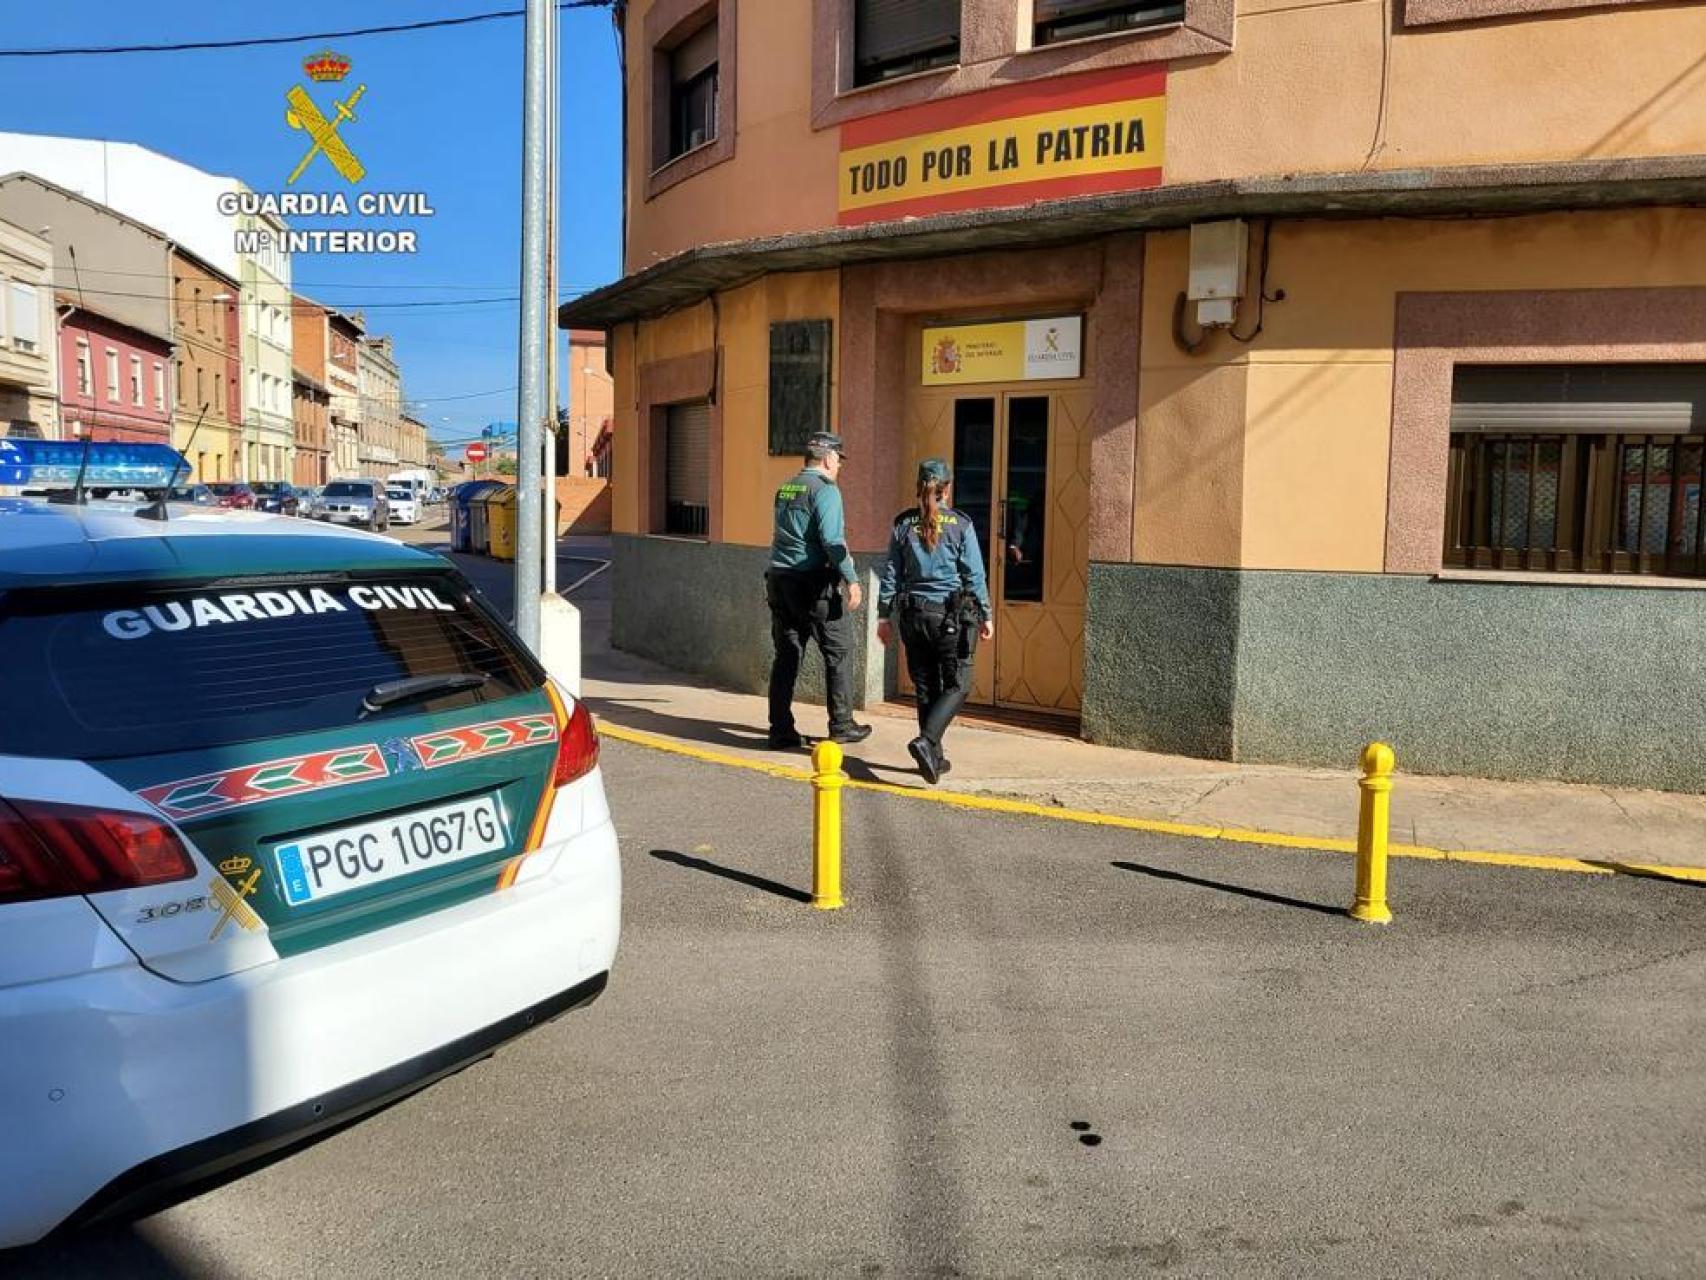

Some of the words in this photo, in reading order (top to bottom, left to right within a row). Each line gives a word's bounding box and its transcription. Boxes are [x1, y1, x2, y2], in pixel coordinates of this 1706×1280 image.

[849, 156, 908, 195] TODO
[922, 144, 972, 182] POR
[988, 136, 1020, 172] LA
[1037, 118, 1145, 165] PATRIA
[103, 587, 348, 640] GUARDIA
[347, 586, 456, 611] CIVIL
[307, 833, 384, 888] PGC
[391, 811, 465, 864] 1067
[292, 880, 302, 891] E
